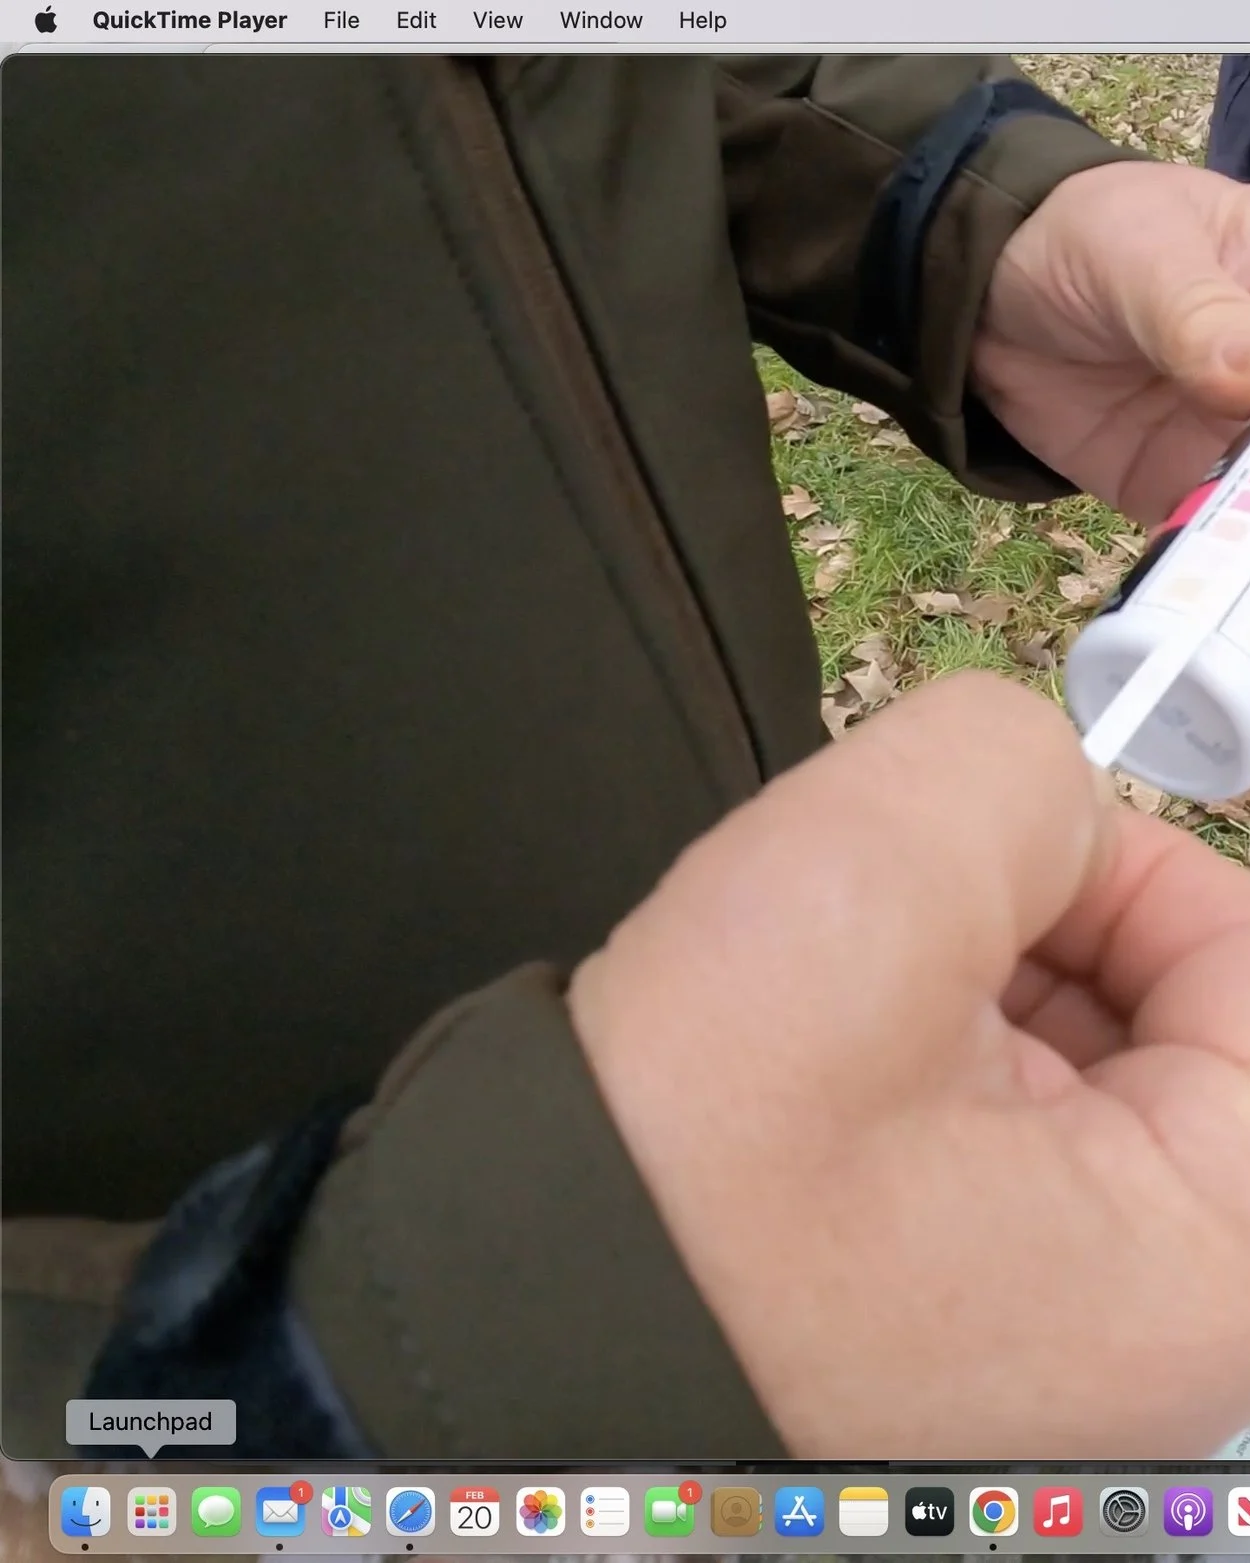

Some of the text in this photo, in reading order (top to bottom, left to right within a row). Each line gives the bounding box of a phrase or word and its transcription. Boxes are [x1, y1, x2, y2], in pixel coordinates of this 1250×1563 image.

[94, 10, 287, 32] QuickTime Player
[325, 11, 359, 28] File
[398, 11, 436, 28] Edit
[474, 11, 523, 28] View
[561, 11, 643, 28] Window
[681, 11, 726, 32] Help
[90, 1412, 211, 1434] Launchpad
[298, 1488, 304, 1498] 1
[465, 1491, 484, 1500] FEB
[687, 1487, 693, 1498] 1
[457, 1505, 492, 1530] 20
[928, 1503, 948, 1520] tv
